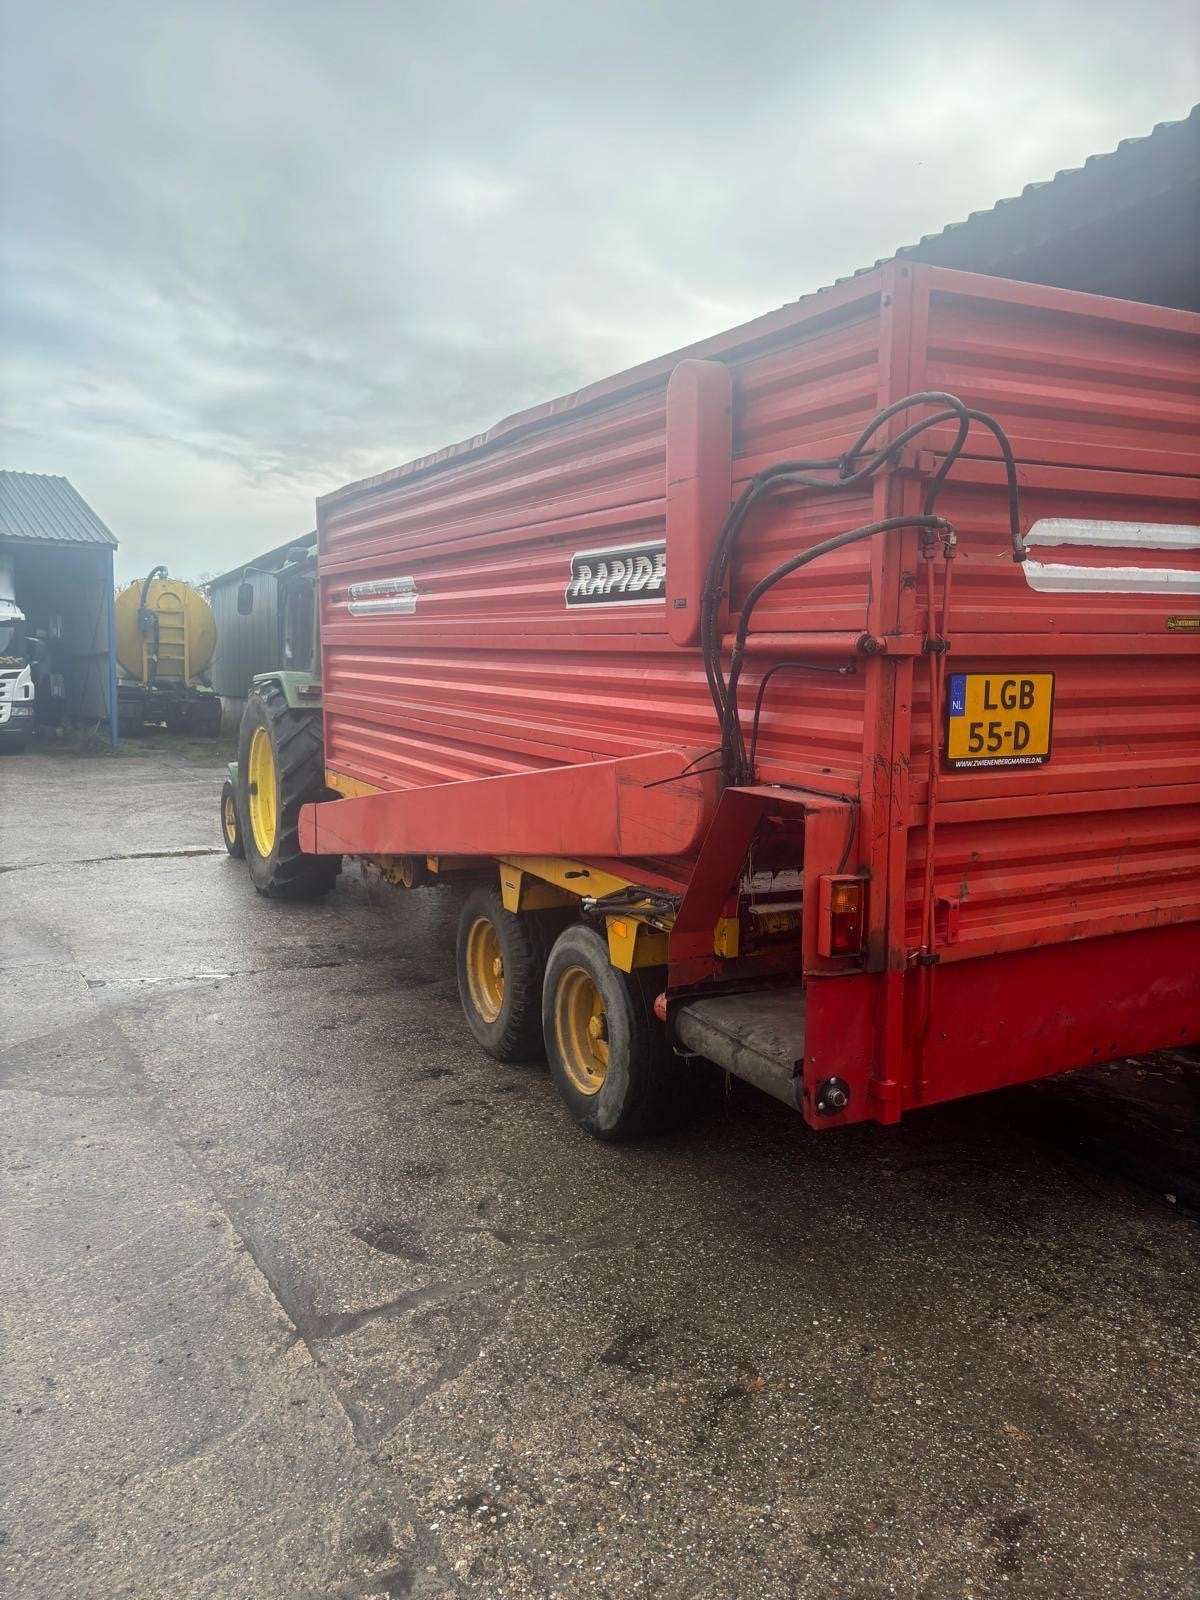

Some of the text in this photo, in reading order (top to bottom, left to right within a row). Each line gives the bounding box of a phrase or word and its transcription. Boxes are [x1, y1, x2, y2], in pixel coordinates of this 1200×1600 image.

[952, 700, 963, 710] NL
[984, 680, 1035, 710] LGB
[968, 721, 1030, 753] 55-D
